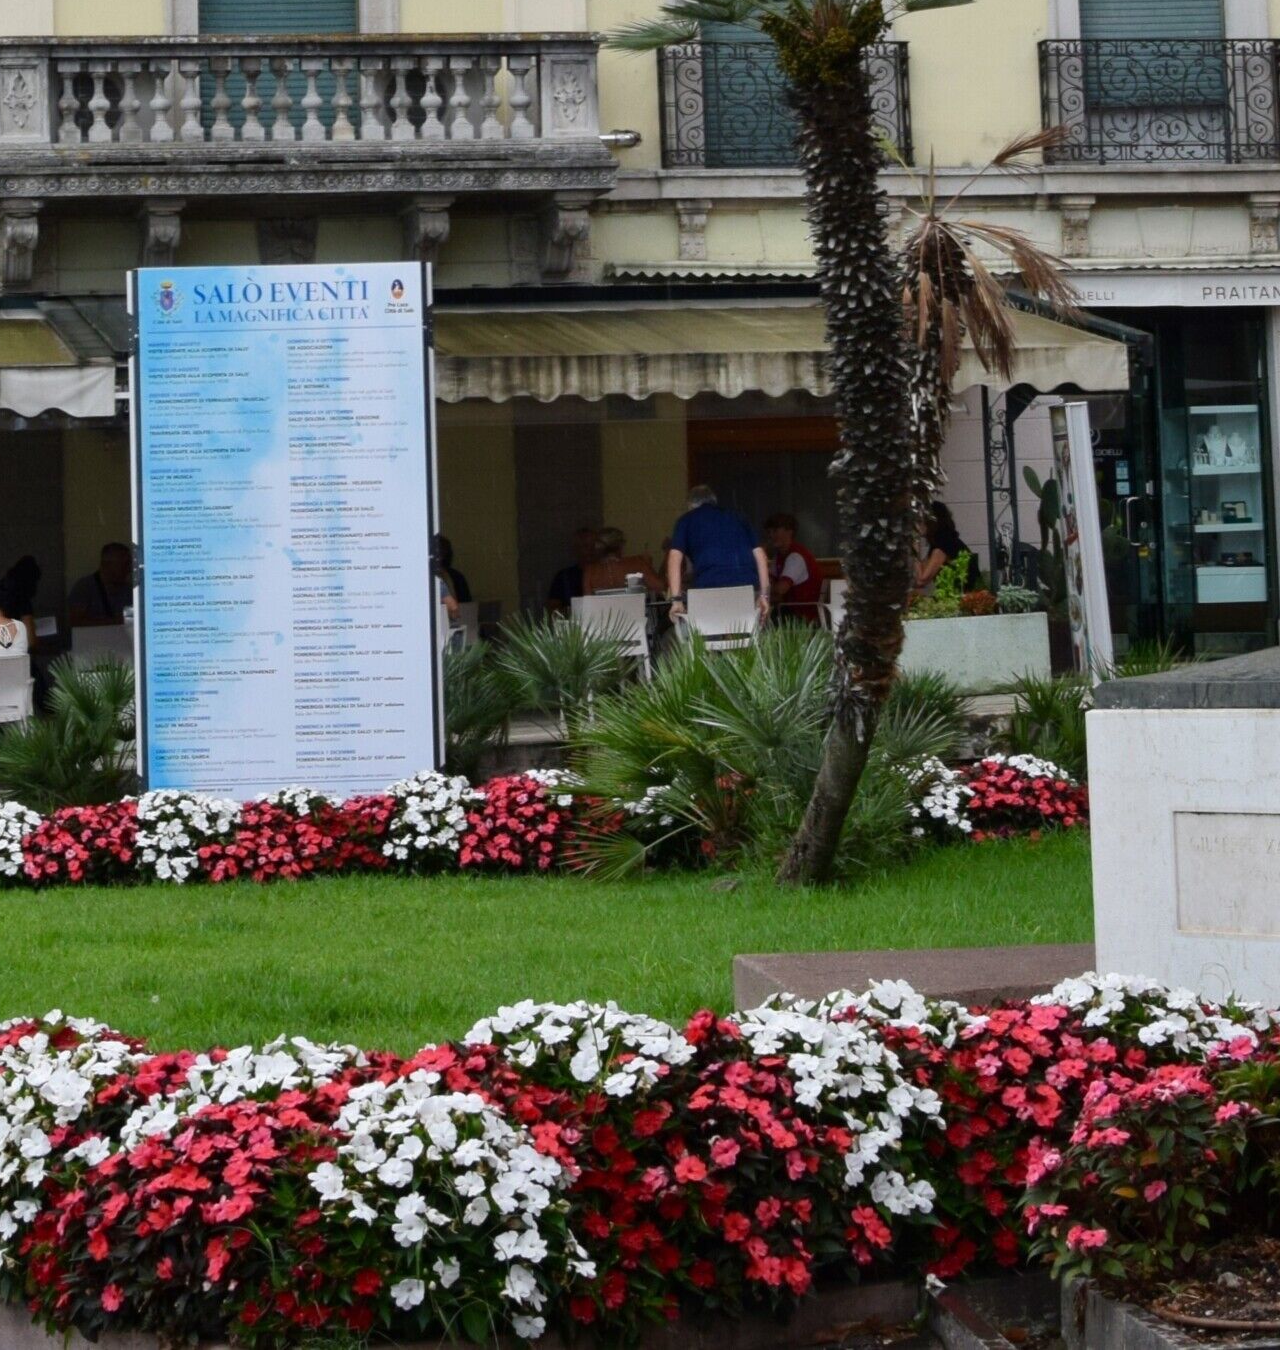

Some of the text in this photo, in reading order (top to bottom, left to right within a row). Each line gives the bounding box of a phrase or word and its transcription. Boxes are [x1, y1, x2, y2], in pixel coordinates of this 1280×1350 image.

[193, 277, 369, 305] SALÒ EVENTI
[194, 310, 215, 324] LA
[217, 308, 314, 323] MAGNIFICA
